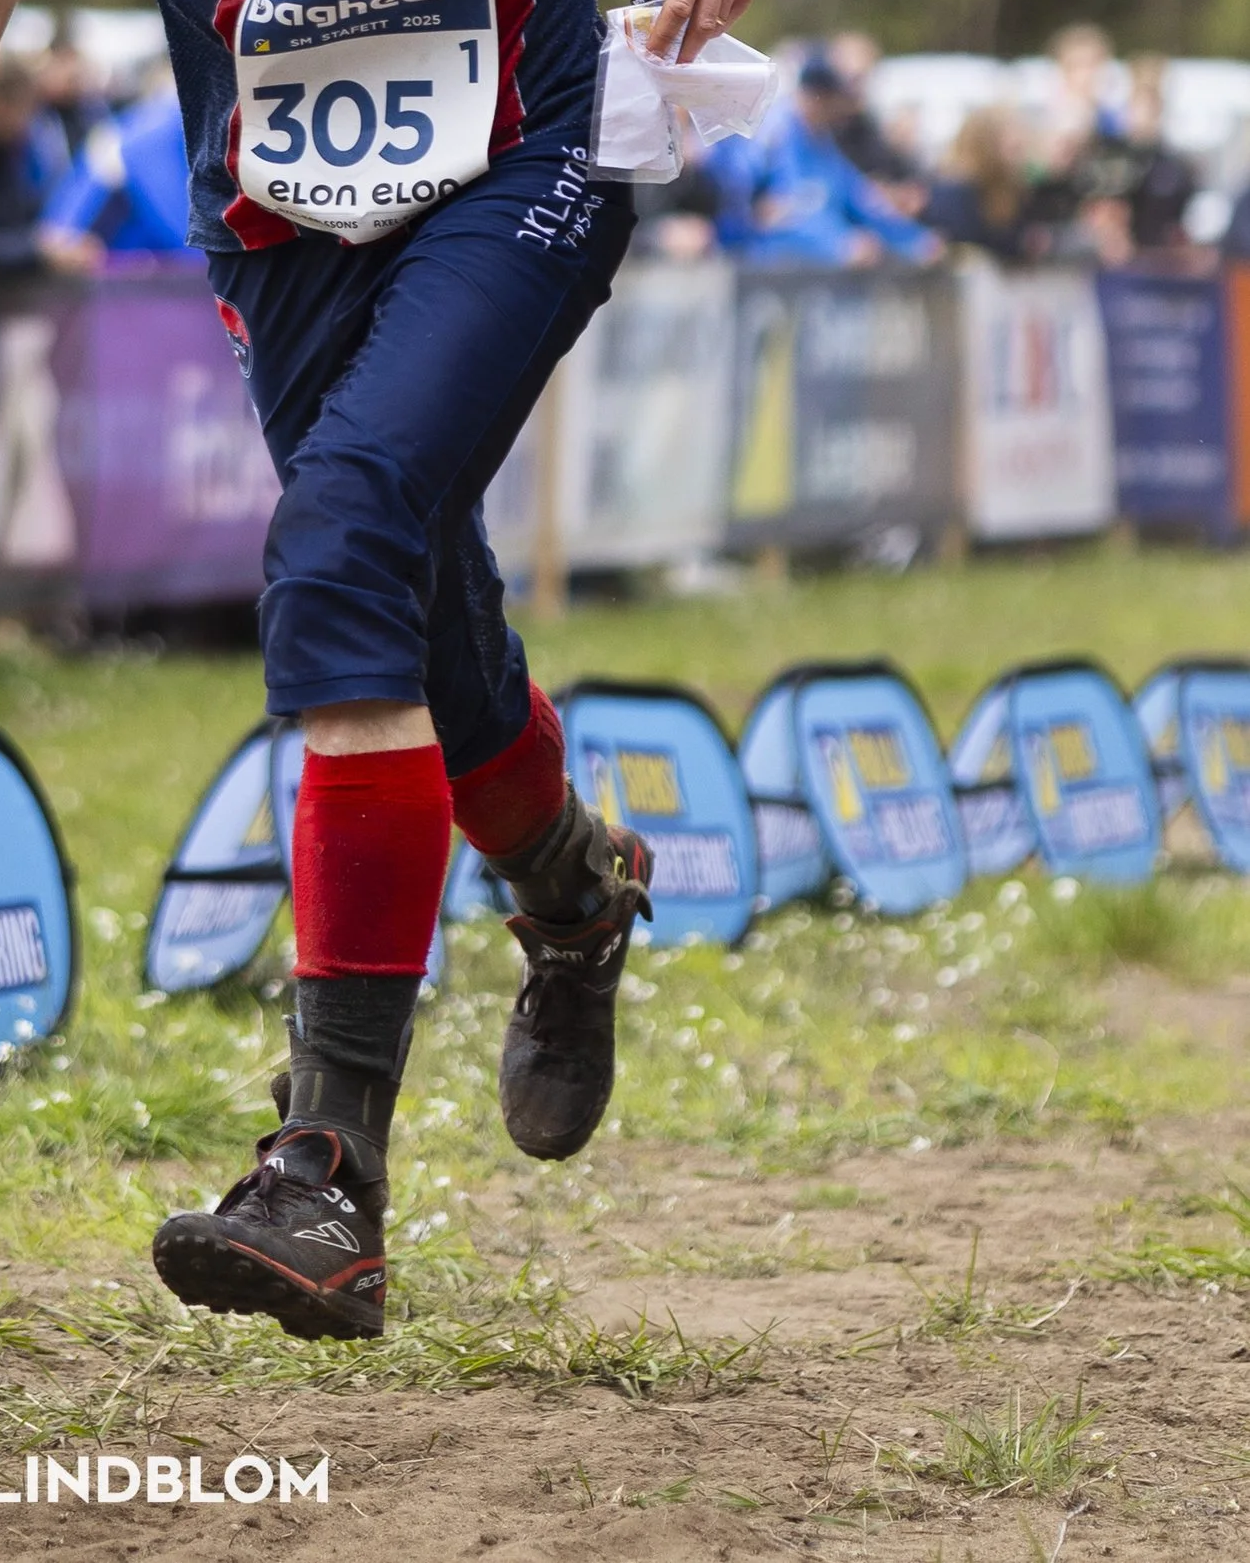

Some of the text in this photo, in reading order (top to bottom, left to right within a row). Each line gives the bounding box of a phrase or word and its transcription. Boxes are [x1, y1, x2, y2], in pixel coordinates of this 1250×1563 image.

[290, 14, 442, 48] SM STAFETT 2025
[459, 39, 479, 84] 1
[250, 80, 435, 168] 305
